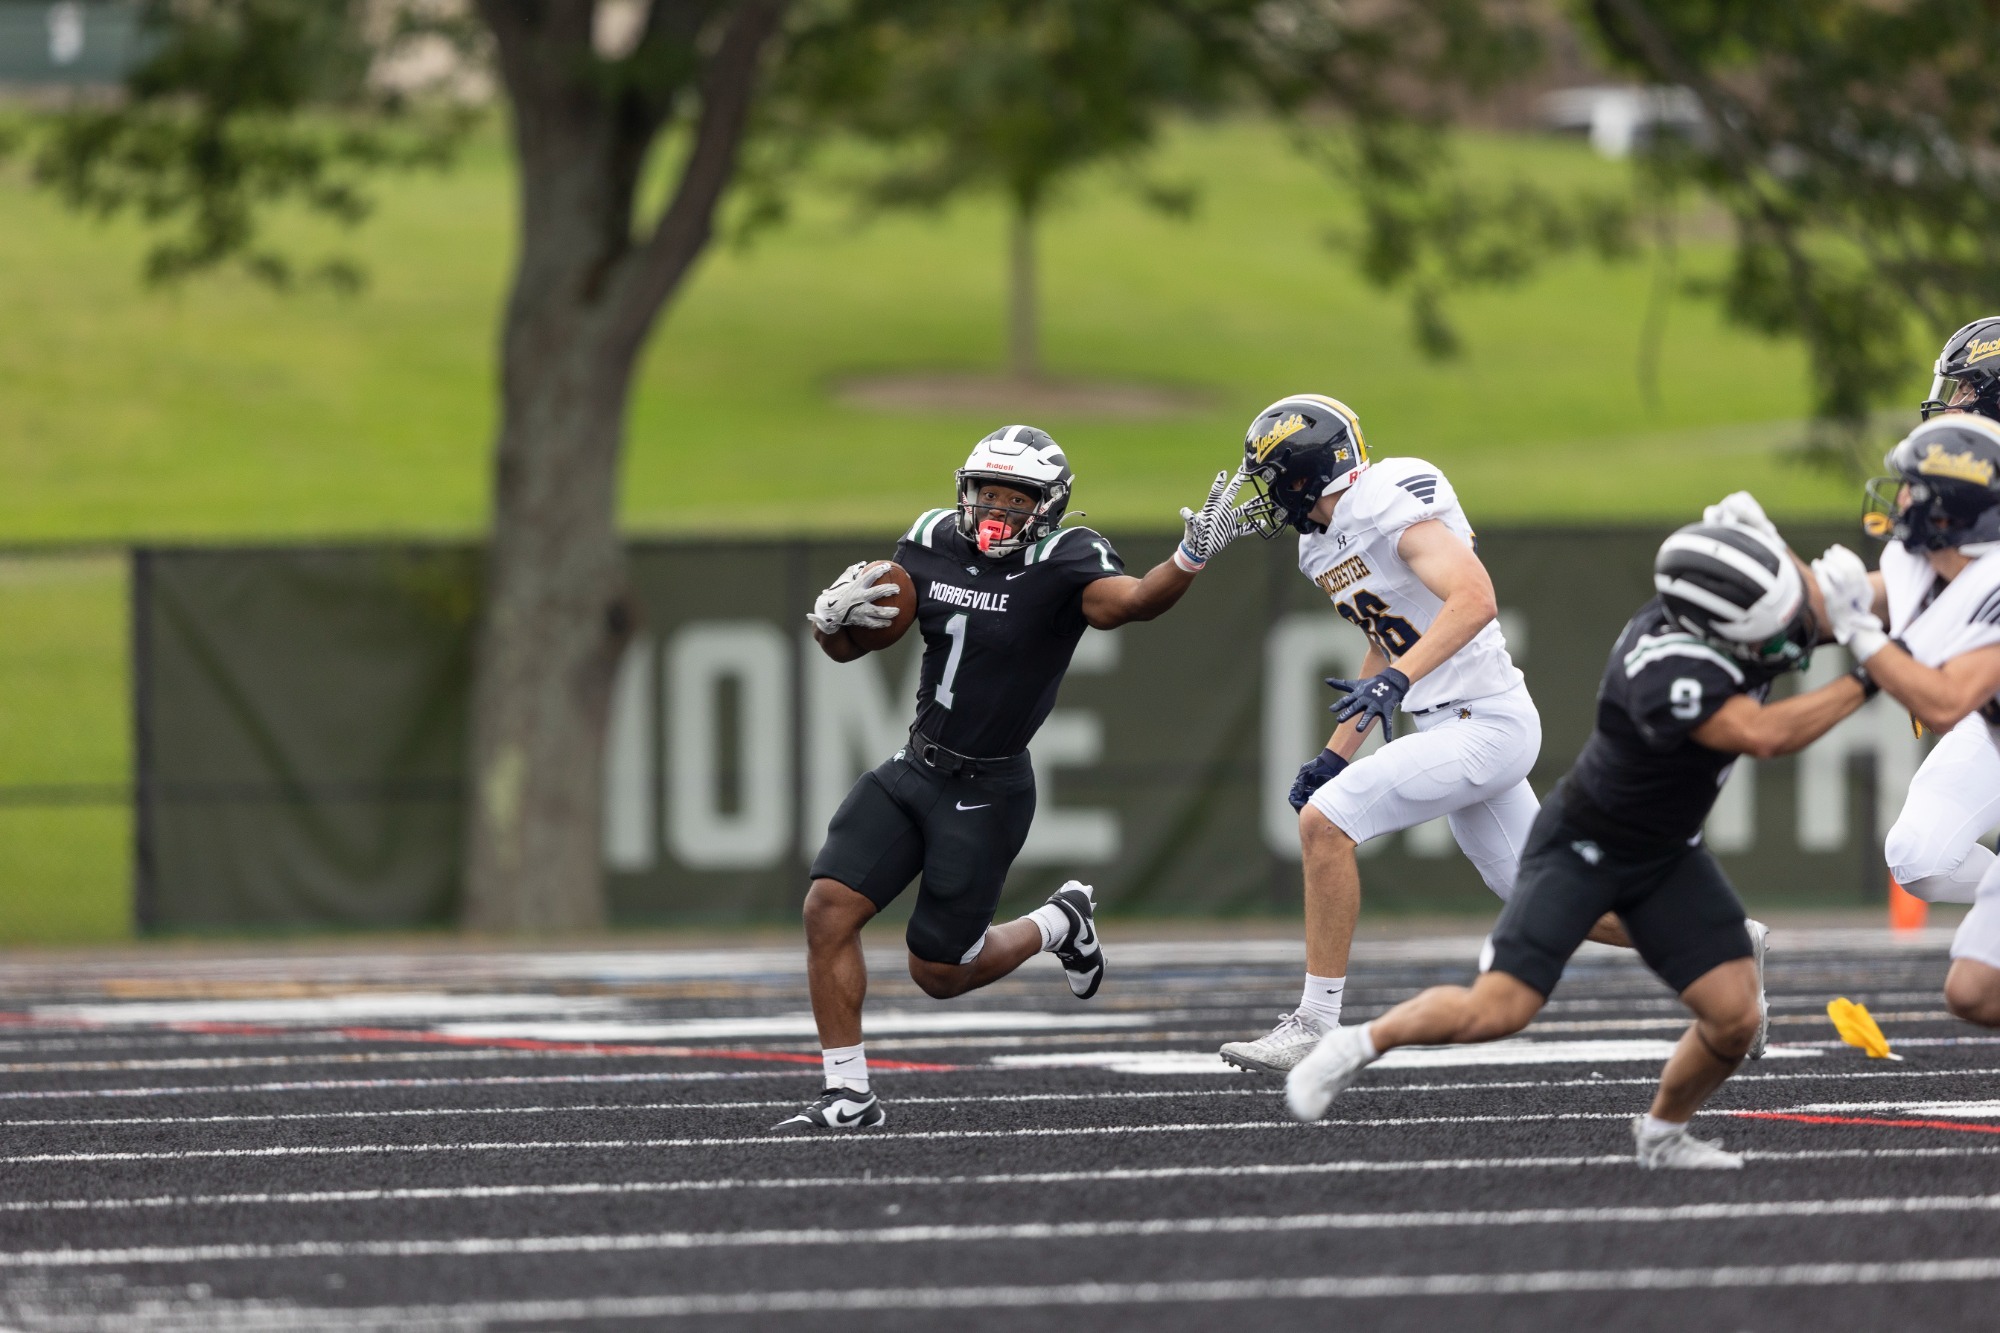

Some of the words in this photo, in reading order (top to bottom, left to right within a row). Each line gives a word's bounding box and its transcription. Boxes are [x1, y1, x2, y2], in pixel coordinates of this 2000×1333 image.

[1252, 413, 1306, 464] Jackets
[1091, 541, 1117, 572] 1
[929, 580, 1010, 613] MORRISVILLE
[934, 611, 970, 711] 1
[1670, 677, 1702, 720] 9
